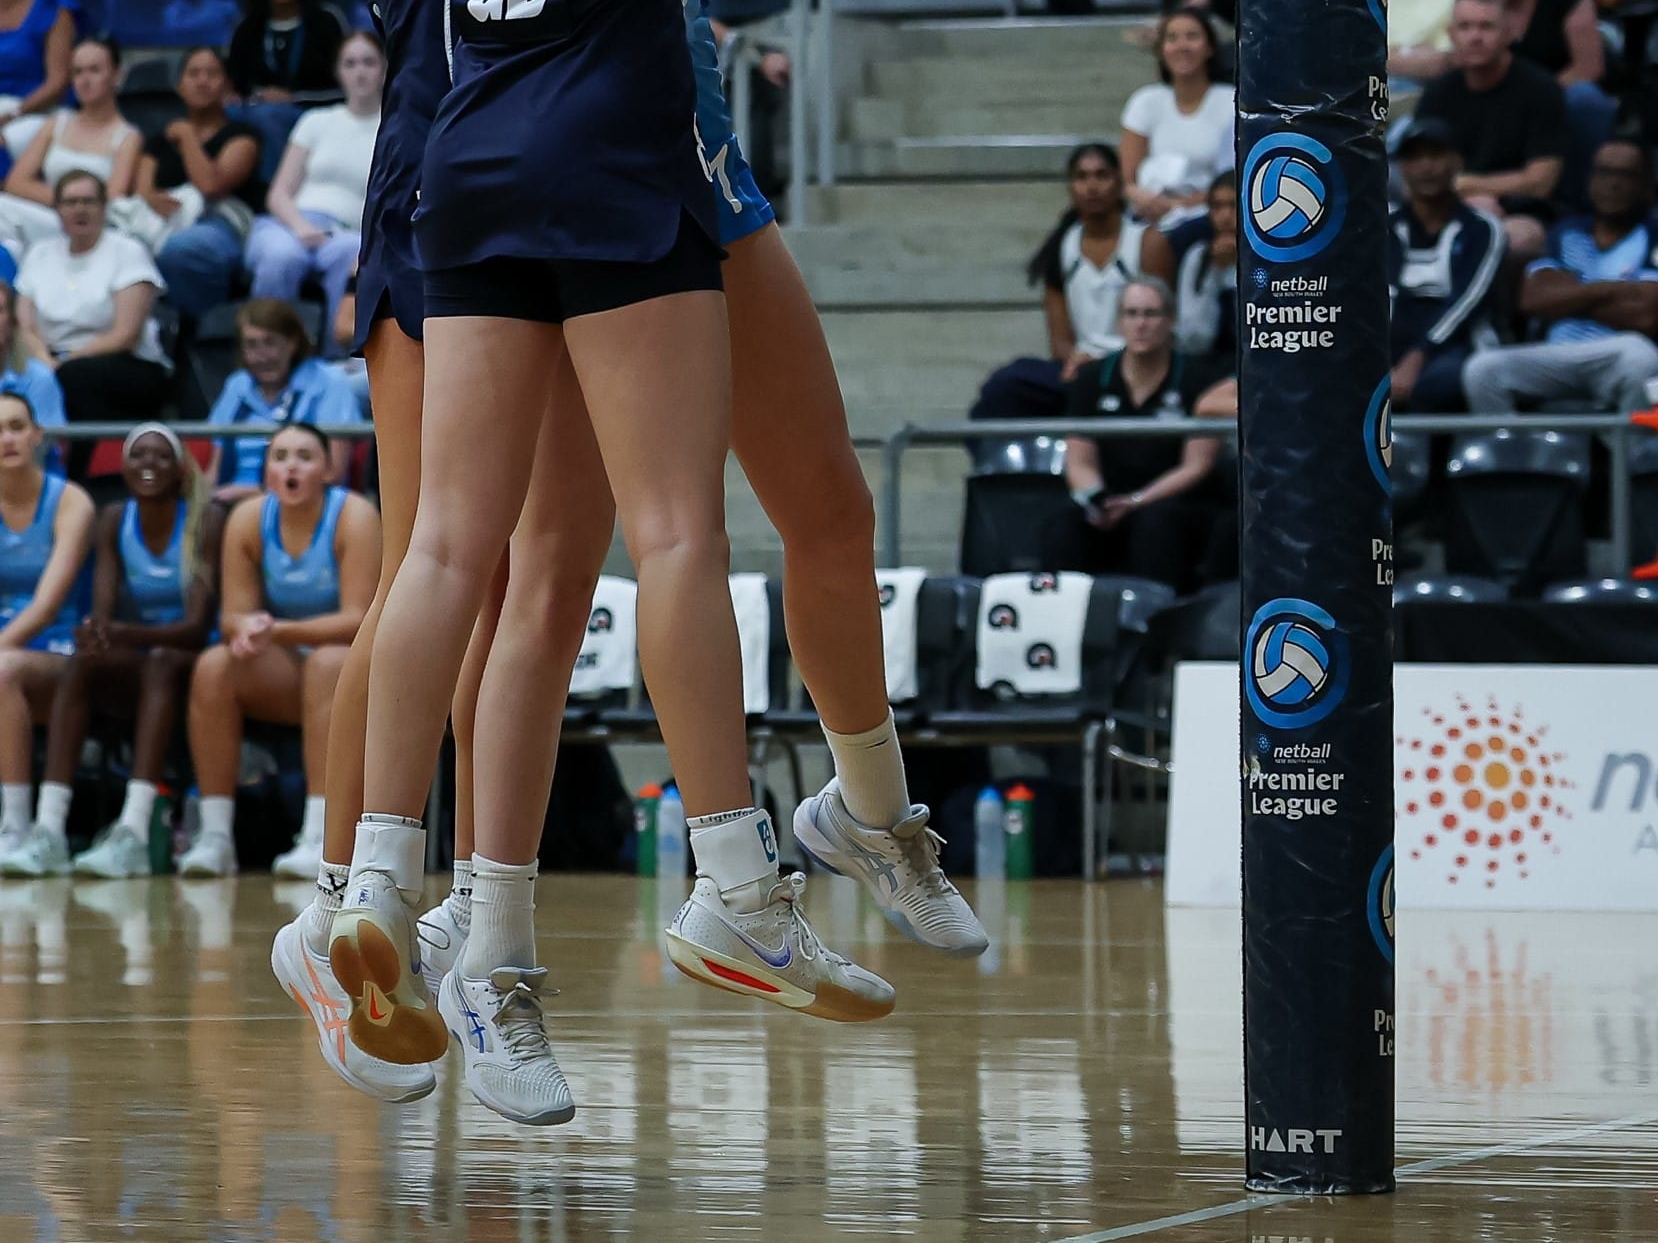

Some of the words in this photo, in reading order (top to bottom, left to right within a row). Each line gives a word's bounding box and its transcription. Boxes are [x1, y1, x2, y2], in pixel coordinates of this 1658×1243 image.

[1271, 275, 1328, 292] netball
[1246, 300, 1342, 325] Premier
[1250, 326, 1335, 353] League
[1273, 743, 1331, 759] netball
[1249, 767, 1345, 790] Premier
[1252, 791, 1338, 820] League
[1251, 1125, 1343, 1154] HART
